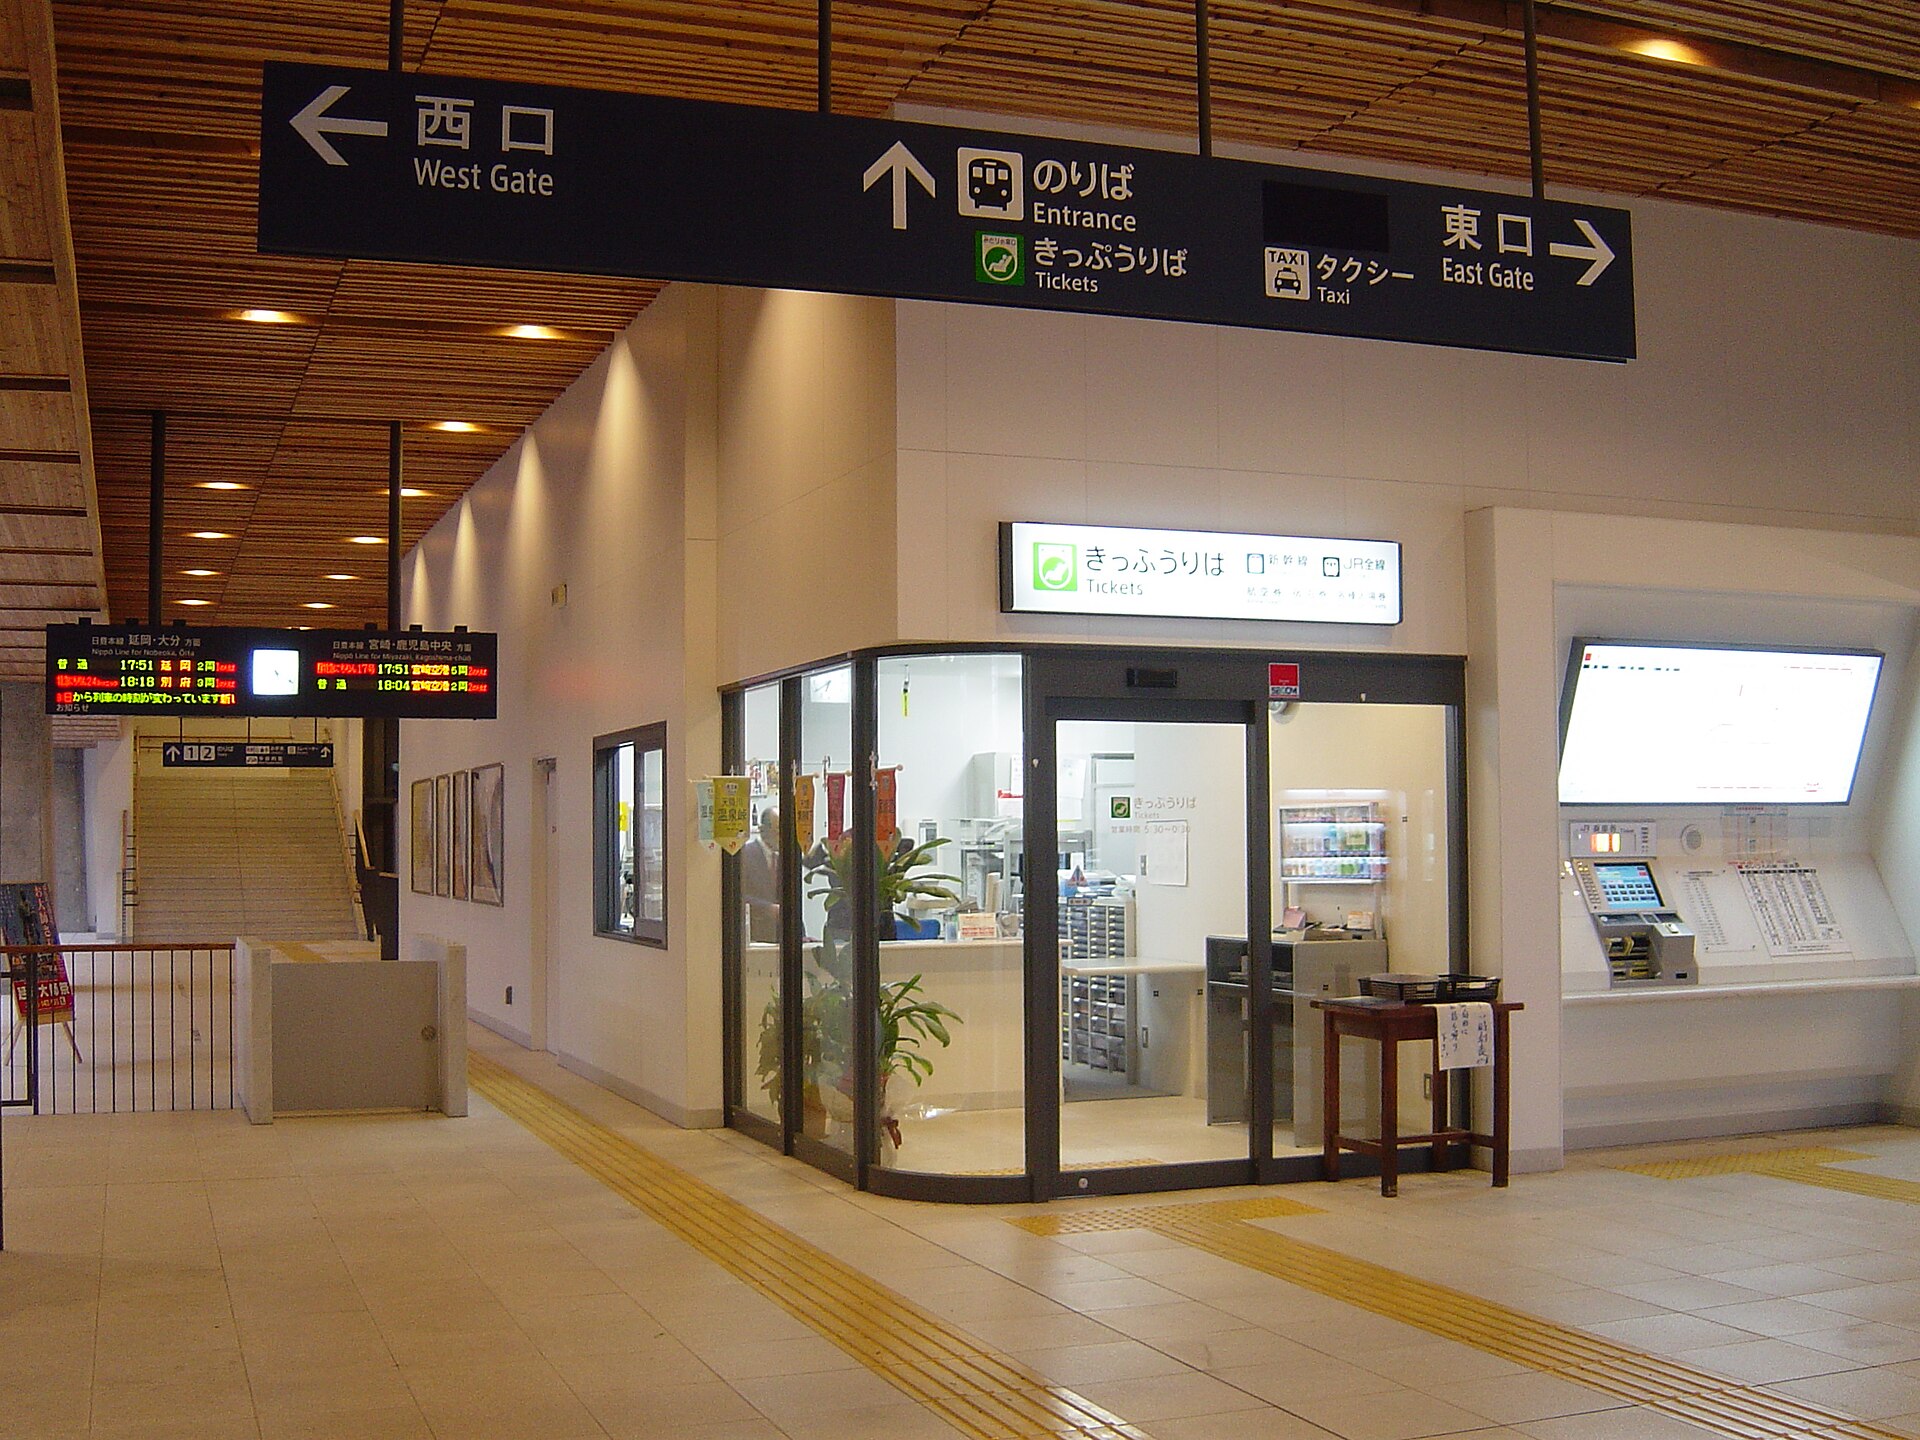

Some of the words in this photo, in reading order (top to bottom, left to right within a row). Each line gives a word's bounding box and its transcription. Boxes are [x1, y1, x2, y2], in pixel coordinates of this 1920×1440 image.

[414, 94, 554, 156] 西口
[414, 157, 481, 190] West
[490, 163, 553, 195] Gate
[1032, 159, 1136, 201] のりば
[1033, 202, 1137, 232] Entrance
[1440, 203, 1534, 257] 東口
[1033, 237, 1188, 278] きっぷうりば
[1268, 250, 1306, 266] TAXI
[1315, 254, 1415, 286] タクシー
[1034, 271, 1099, 293] Tickets
[1442, 257, 1483, 287] East
[1488, 263, 1534, 291] Gate
[1317, 286, 1351, 305] Taxi
[1086, 579, 1144, 597] Tickets
[120, 659, 154, 671] 17:51
[378, 663, 409, 675] 17:51
[120, 675, 155, 688] 18:18
[378, 679, 411, 691] 18:04
